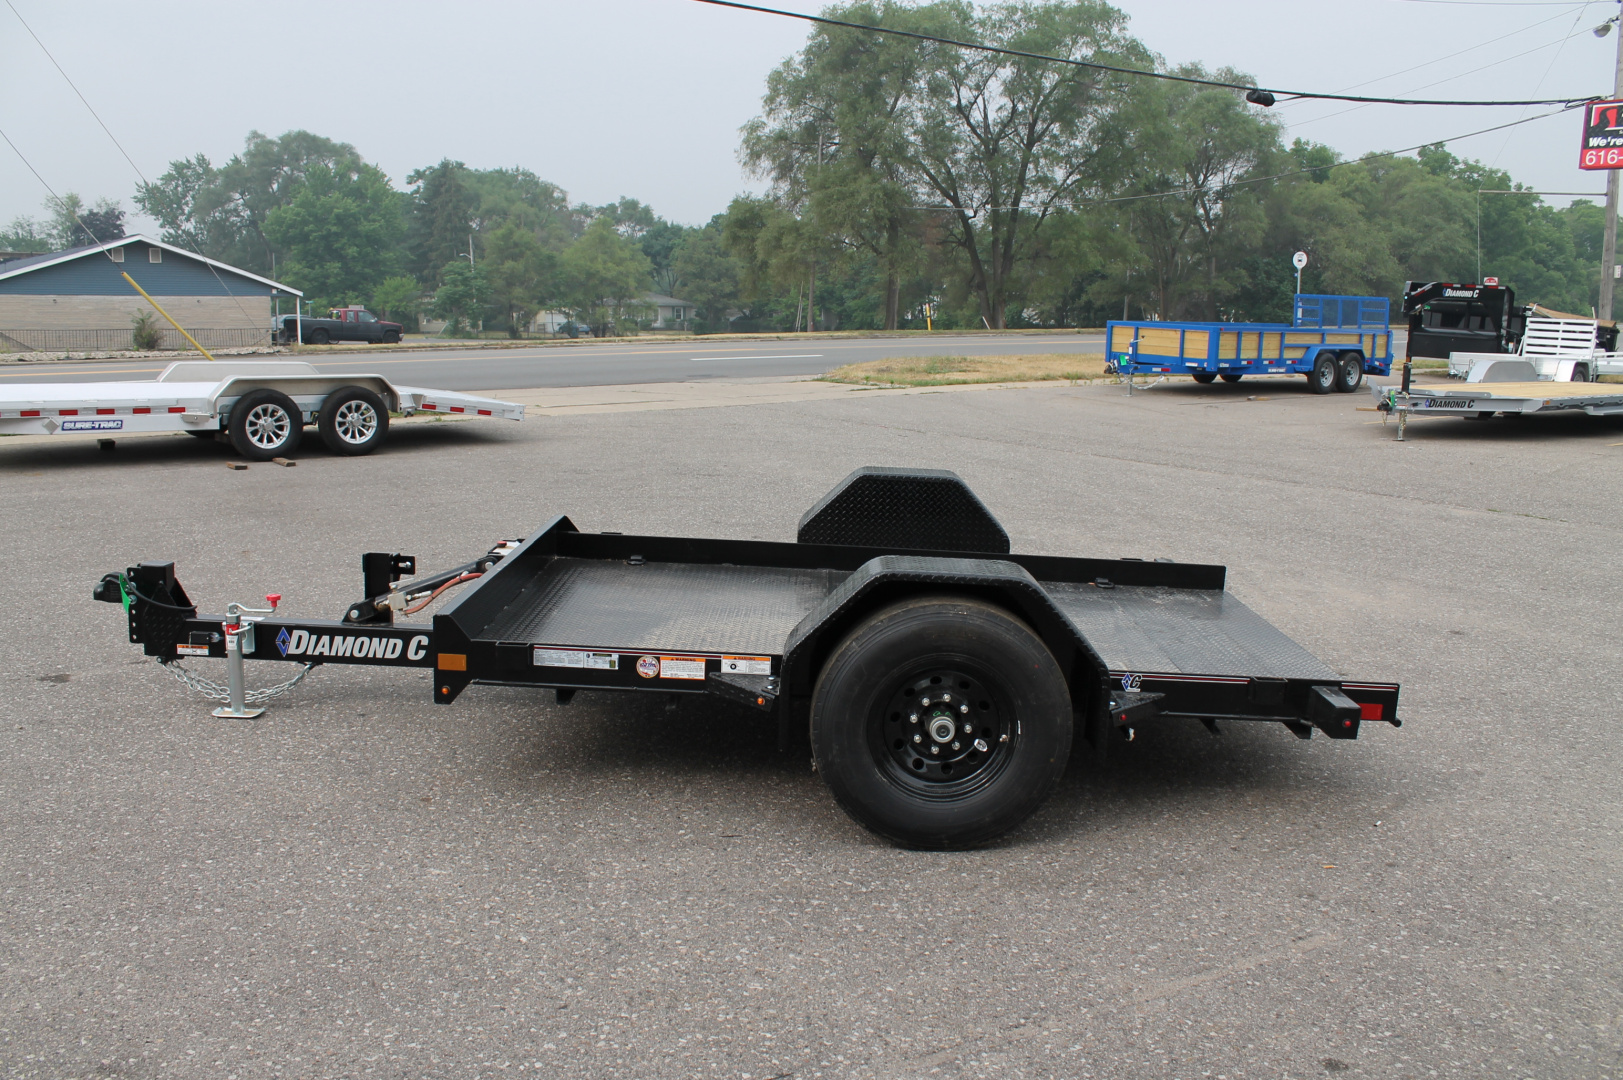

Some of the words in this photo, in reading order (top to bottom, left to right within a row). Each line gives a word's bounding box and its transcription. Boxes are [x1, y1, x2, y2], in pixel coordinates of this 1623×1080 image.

[1588, 136, 1623, 148] We're
[1445, 288, 1473, 298] DIAMOND
[1473, 289, 1480, 298] C
[1428, 398, 1467, 408] DIAMOND
[1467, 399, 1475, 409] C
[63, 421, 121, 430] SURE-TRAC
[287, 629, 403, 660] DIAMOND
[407, 635, 429, 661] C
